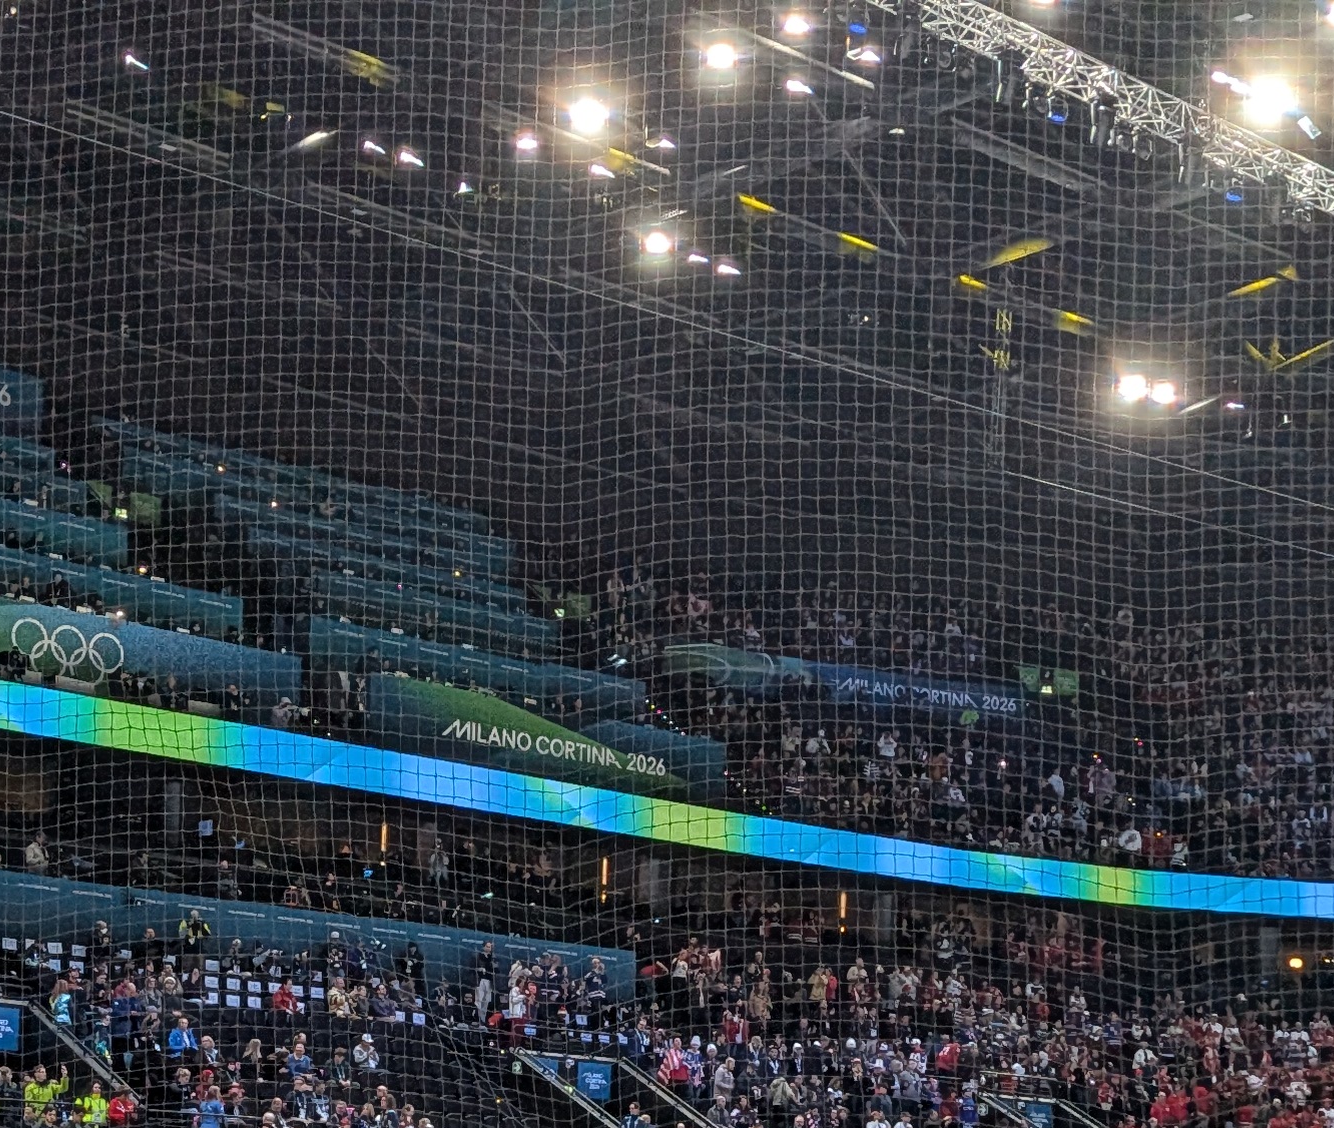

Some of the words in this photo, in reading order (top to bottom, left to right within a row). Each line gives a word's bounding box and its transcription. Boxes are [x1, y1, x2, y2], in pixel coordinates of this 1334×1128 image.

[982, 695, 1017, 712] 2026
[441, 719, 532, 752] MILANO
[535, 736, 623, 769] CORTINA
[626, 752, 667, 777] 2026
